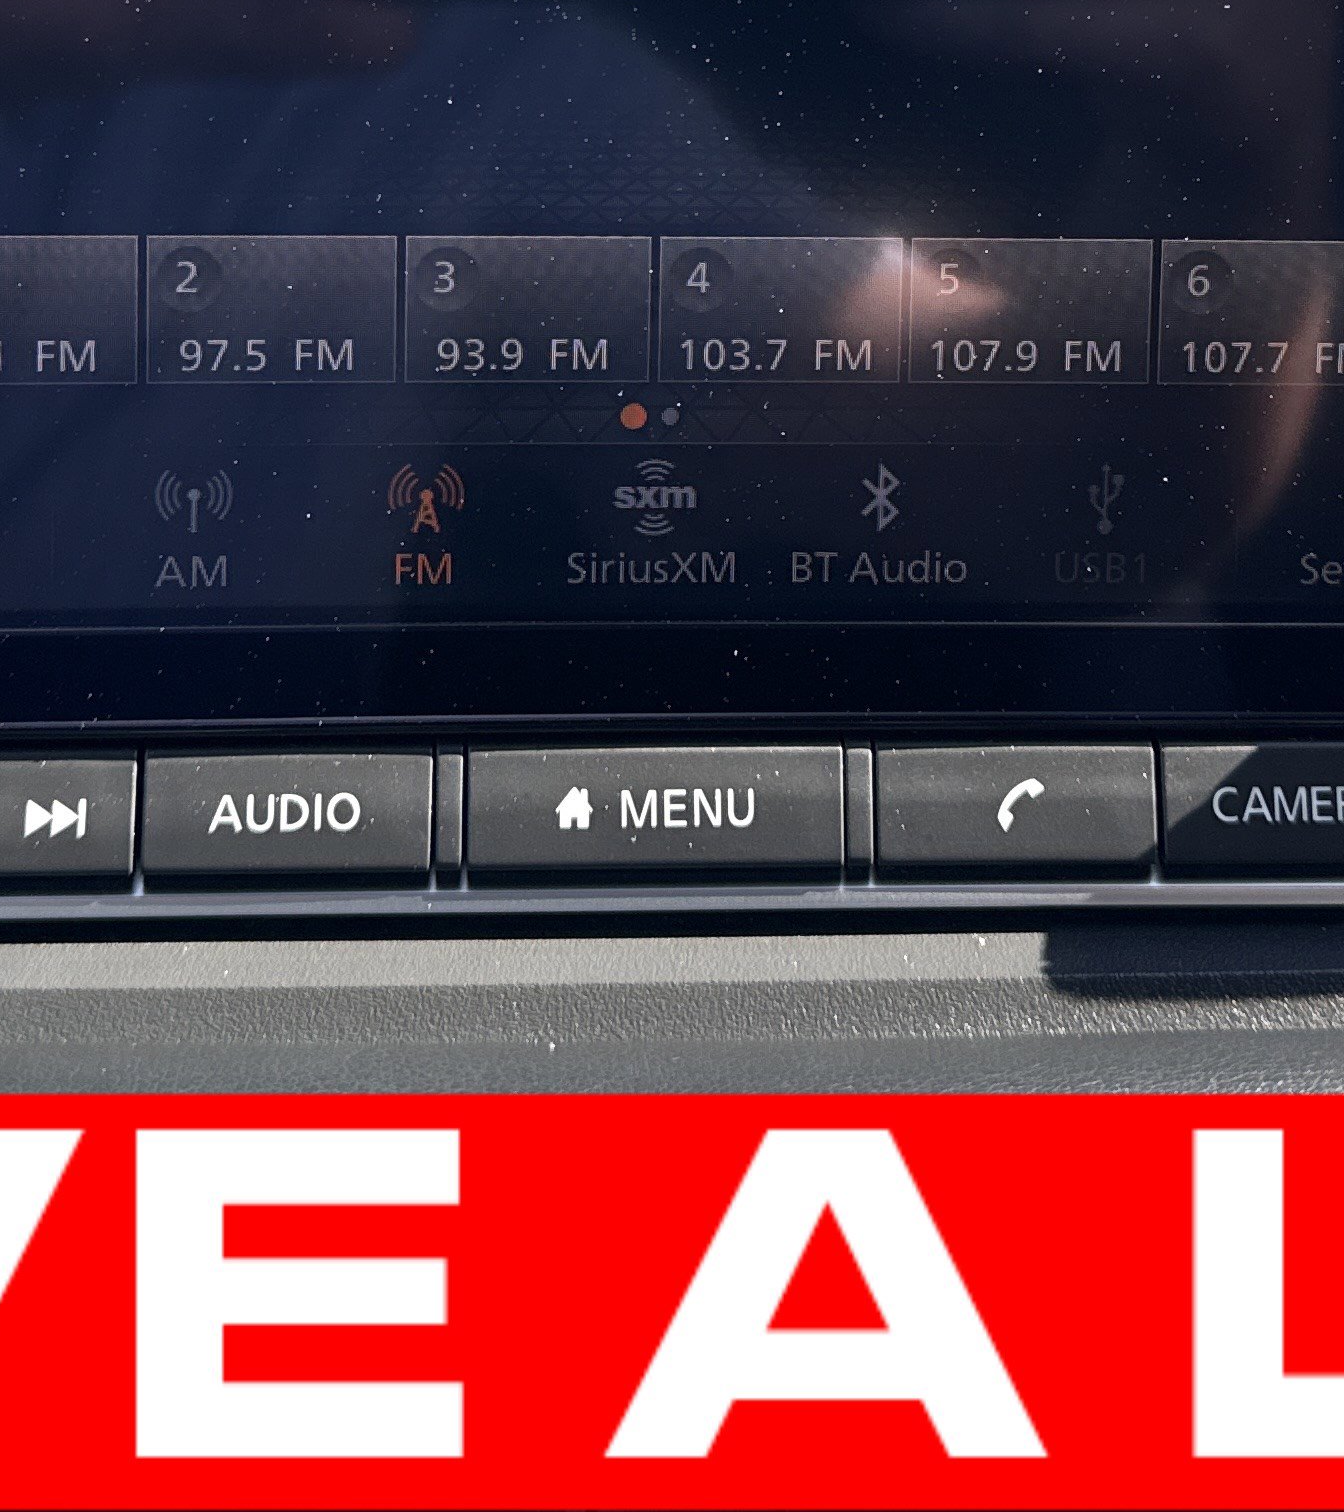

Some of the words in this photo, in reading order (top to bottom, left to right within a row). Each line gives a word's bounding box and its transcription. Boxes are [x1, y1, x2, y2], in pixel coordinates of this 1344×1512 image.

[174, 263, 199, 295] 2
[432, 263, 456, 295] 3
[685, 263, 711, 295] 4
[938, 263, 960, 296] 5
[1186, 264, 1211, 296] 6
[34, 340, 98, 374] FM
[179, 339, 267, 374] 97.5
[293, 339, 355, 373] FM
[436, 338, 524, 373] 93.9
[549, 338, 610, 372] FM
[679, 339, 788, 374] 103.7
[813, 339, 872, 373] FM
[929, 340, 1038, 374] 107.9
[1063, 341, 1123, 374] FM
[1182, 341, 1289, 376] 107.7
[614, 485, 697, 509] sxm
[155, 555, 229, 589] AM
[394, 552, 454, 586] FM
[566, 551, 737, 586] SiriusXM
[790, 551, 838, 584] BT
[849, 551, 968, 585] Audio
[1054, 551, 1149, 583] USB1
[207, 792, 362, 835] AUDIO
[618, 788, 756, 830] MENU
